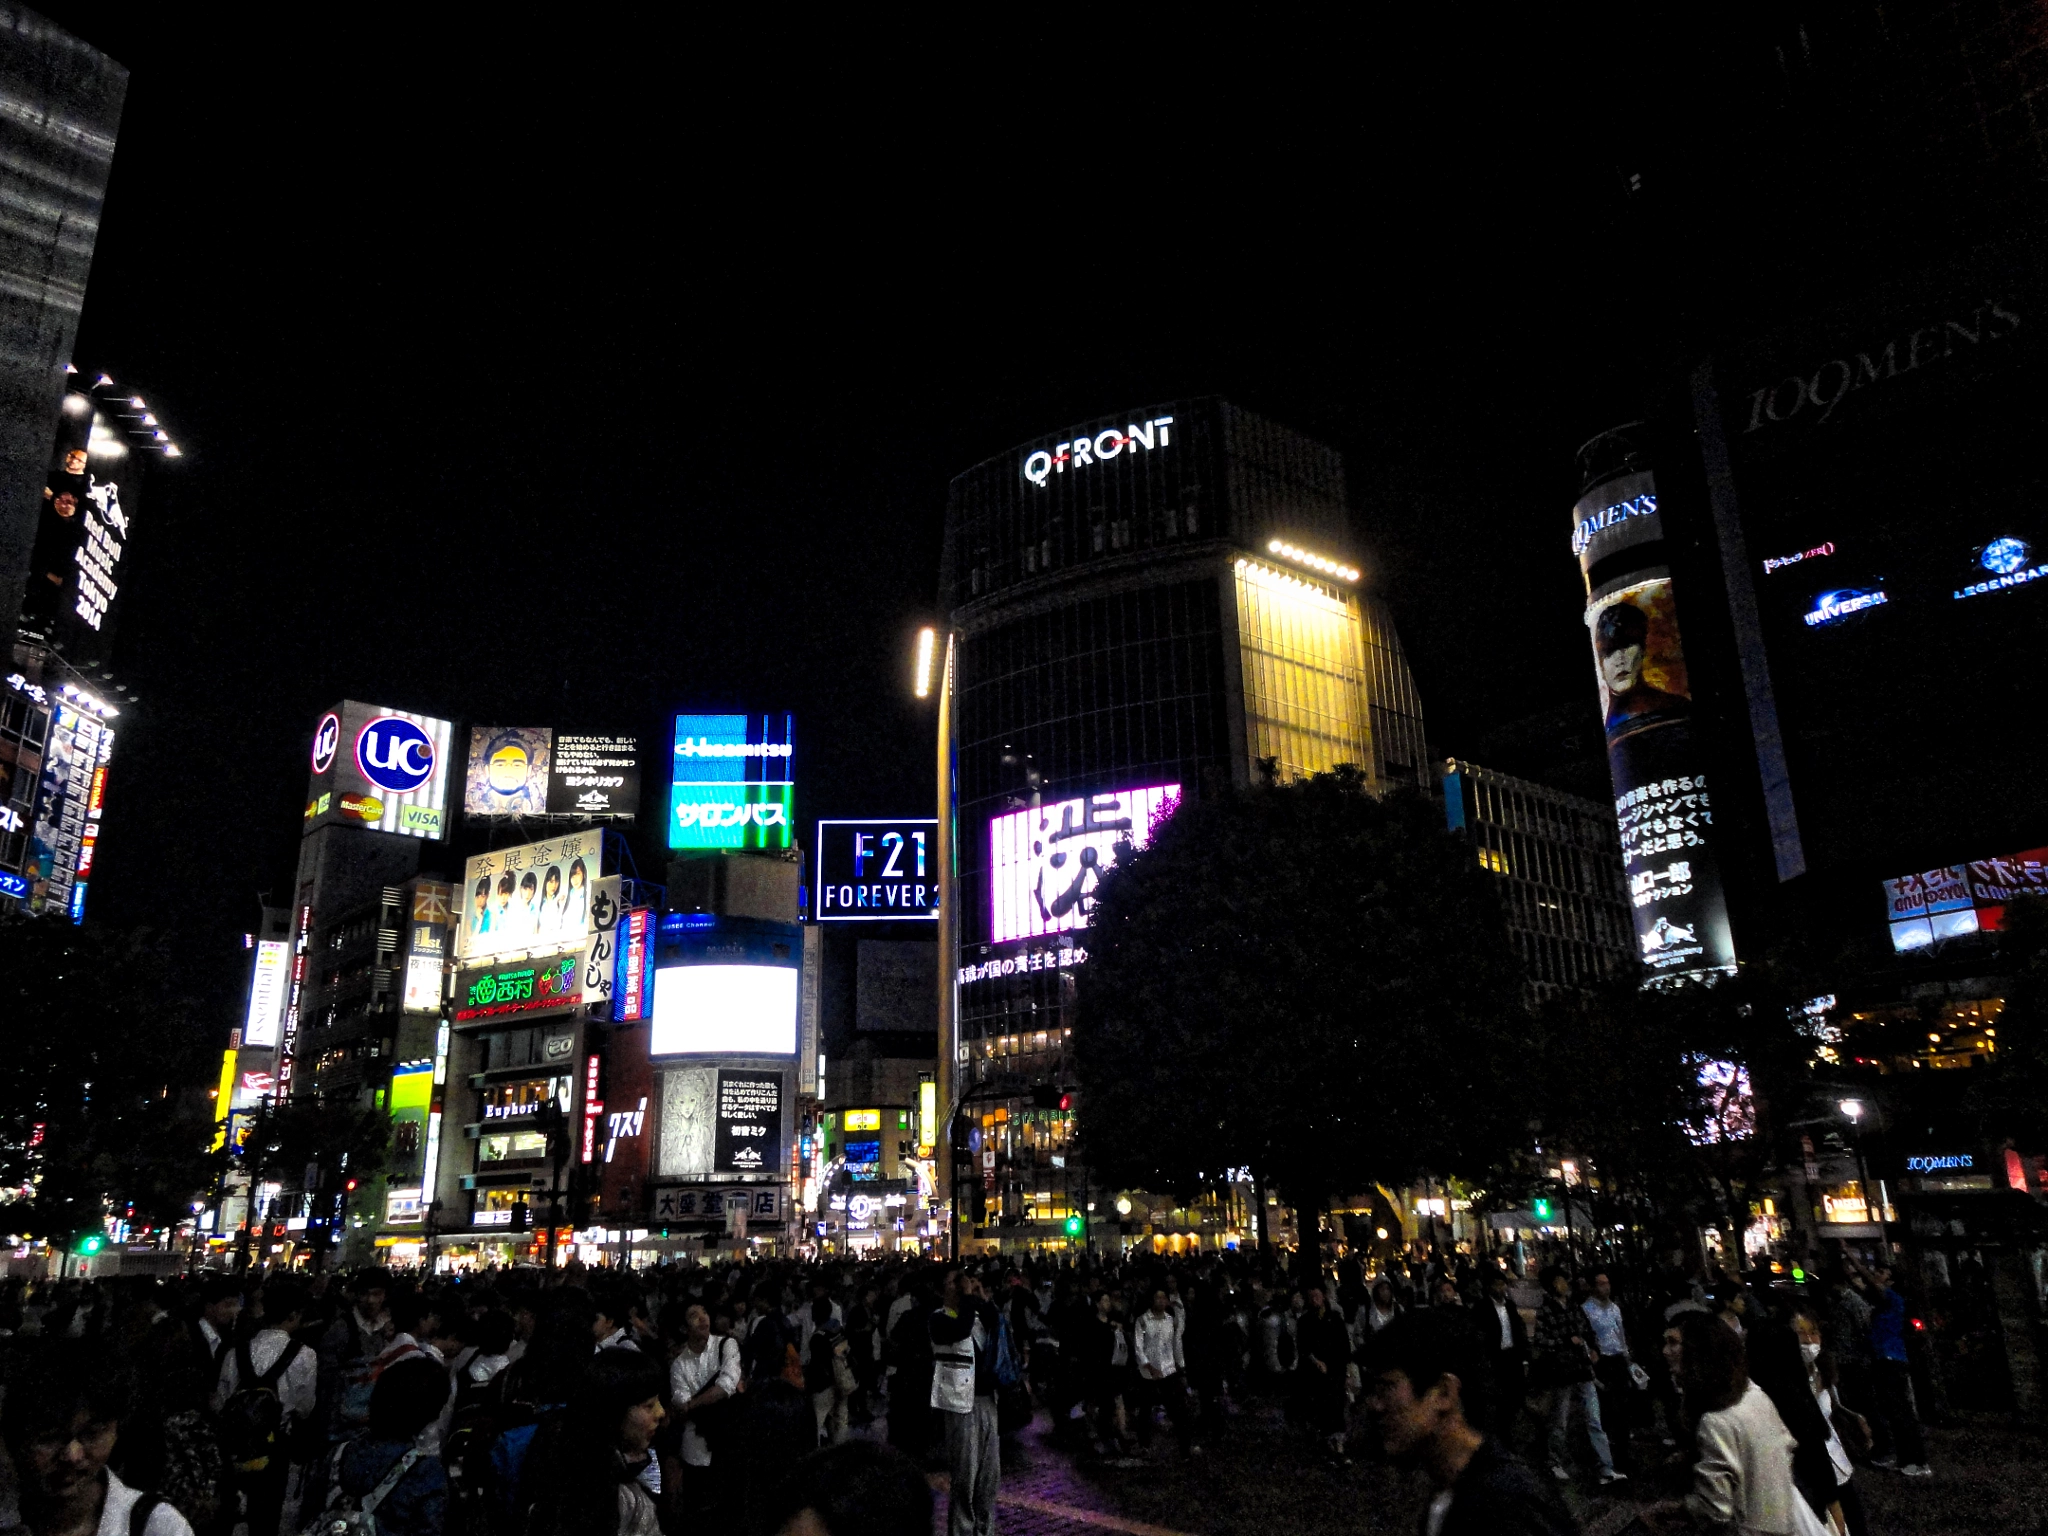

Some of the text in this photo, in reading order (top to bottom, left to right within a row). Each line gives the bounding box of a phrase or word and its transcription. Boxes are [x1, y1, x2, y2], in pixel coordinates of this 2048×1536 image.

[1024, 416, 1174, 488] QFRONT
[84, 510, 122, 562] Red Bull
[86, 534, 114, 575] Music
[75, 546, 118, 601] Academy
[78, 569, 108, 614] Tokyo
[75, 594, 102, 631] 2014
[1804, 591, 1888, 626] UNIVERSAL
[366, 731, 430, 777] UC
[341, 800, 385, 816] MasterCard
[407, 812, 440, 827] VISA
[676, 802, 787, 828] サロンパス
[825, 885, 927, 908] FOREVER
[585, 890, 618, 998] もんじゃ
[624, 915, 642, 1014] 三千里薬品
[497, 977, 534, 1002] 西村
[731, 1125, 767, 1137] 初音ミク
[660, 1188, 776, 1215] 大盛堂店
